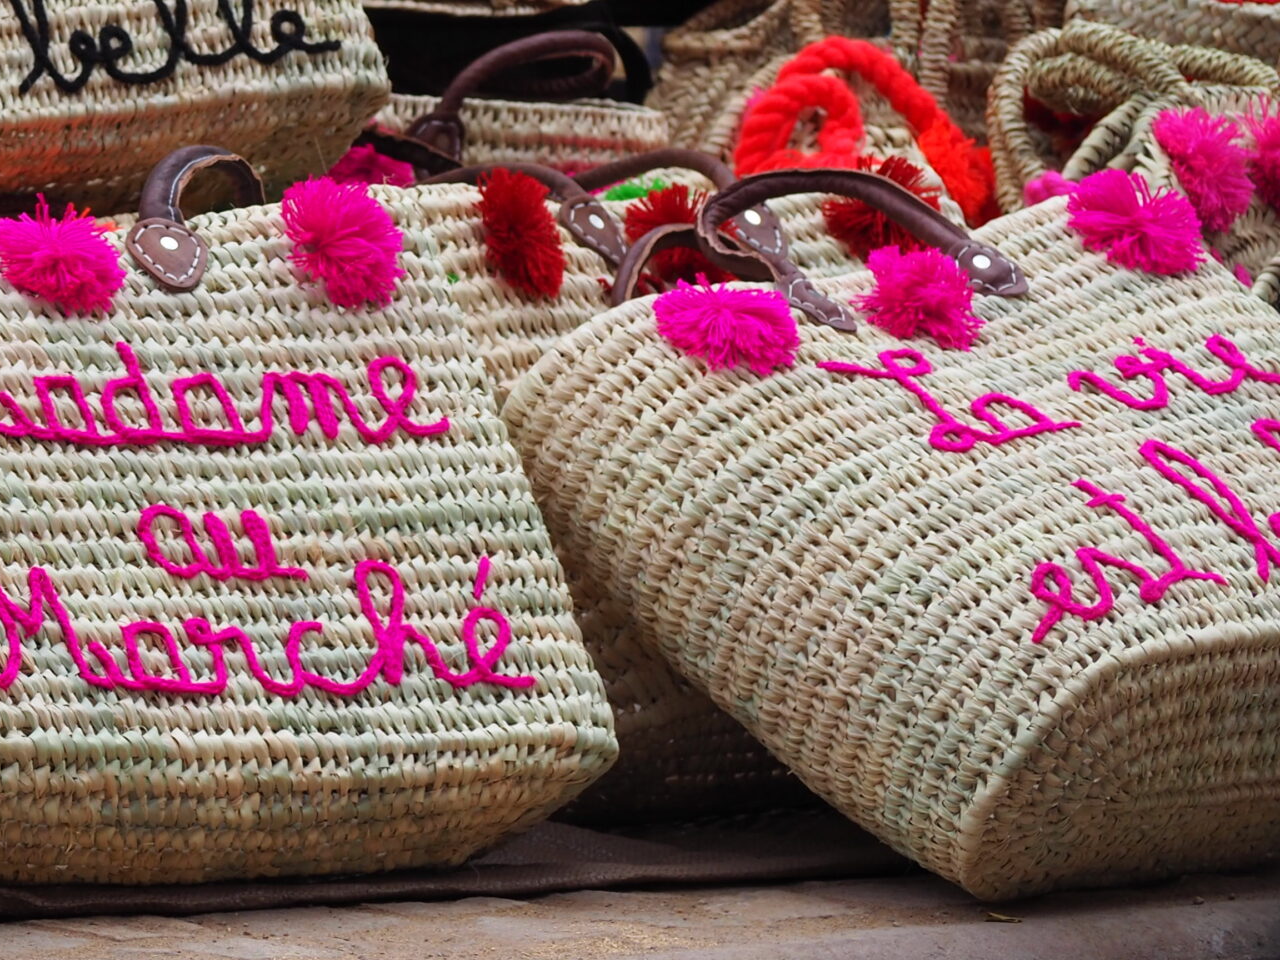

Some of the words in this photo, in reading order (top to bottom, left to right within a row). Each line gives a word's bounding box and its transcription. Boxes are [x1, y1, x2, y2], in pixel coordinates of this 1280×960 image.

[816, 347, 1083, 453] La
[1066, 333, 1280, 411] vie
[135, 502, 311, 584] au
[1030, 478, 1228, 645] est
